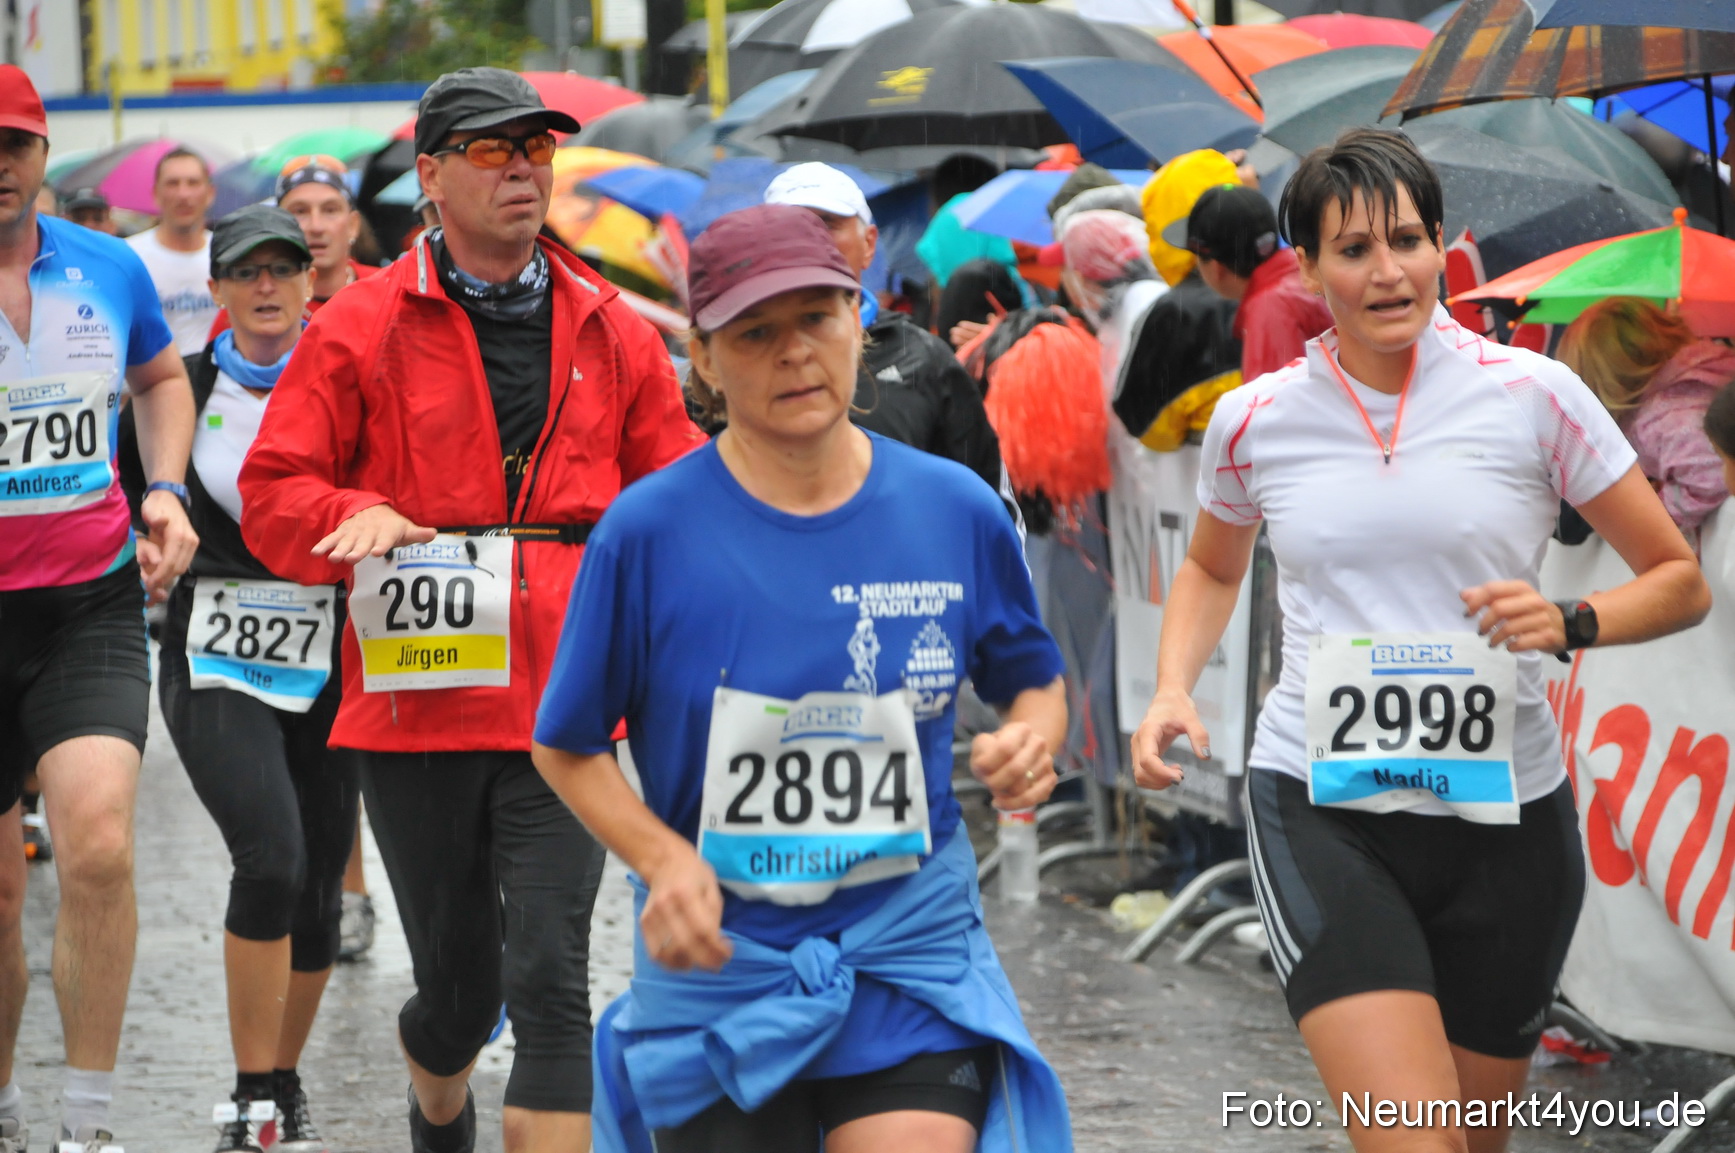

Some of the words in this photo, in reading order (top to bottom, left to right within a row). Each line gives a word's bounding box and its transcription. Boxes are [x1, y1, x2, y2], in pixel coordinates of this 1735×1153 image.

[66, 324, 109, 335] ZURICH
[7, 474, 82, 495] Andreas
[397, 544, 460, 560] BOCK
[831, 584, 860, 604] 12.
[861, 581, 963, 602] NEUMARKTER
[379, 576, 475, 632] 290
[859, 598, 947, 618] STADTLAUF
[203, 612, 319, 663] 2827
[397, 644, 458, 670] Jürgen
[1372, 645, 1453, 664] BOCK
[243, 668, 272, 689] Ute
[1329, 684, 1496, 753] 2998
[725, 749, 911, 826] 2894
